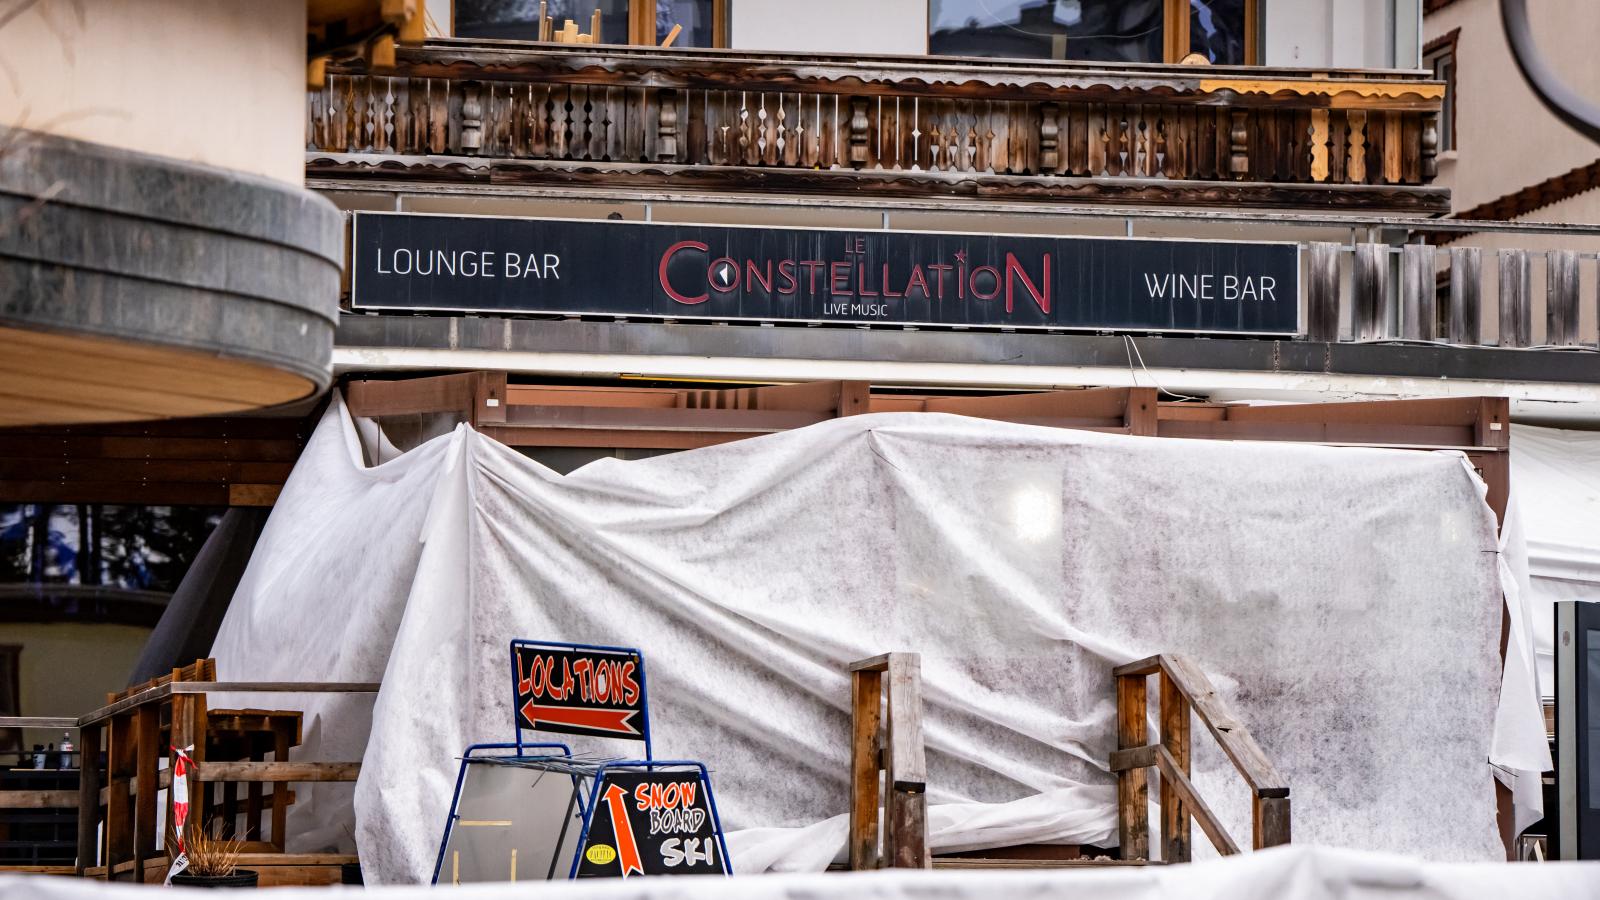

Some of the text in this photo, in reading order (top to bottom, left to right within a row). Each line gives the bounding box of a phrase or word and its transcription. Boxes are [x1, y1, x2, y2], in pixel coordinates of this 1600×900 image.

[845, 236, 866, 255] LE
[377, 247, 560, 280] LOUNGE BAR
[658, 240, 1051, 315] CONSTELLATION
[1144, 272, 1277, 301] WINE BAR
[823, 302, 888, 317] LIVE MUSIC
[517, 653, 640, 706] LOCATIONS
[634, 782, 696, 811] SNOW
[650, 808, 706, 835] BOARD
[660, 837, 714, 867] SKI
